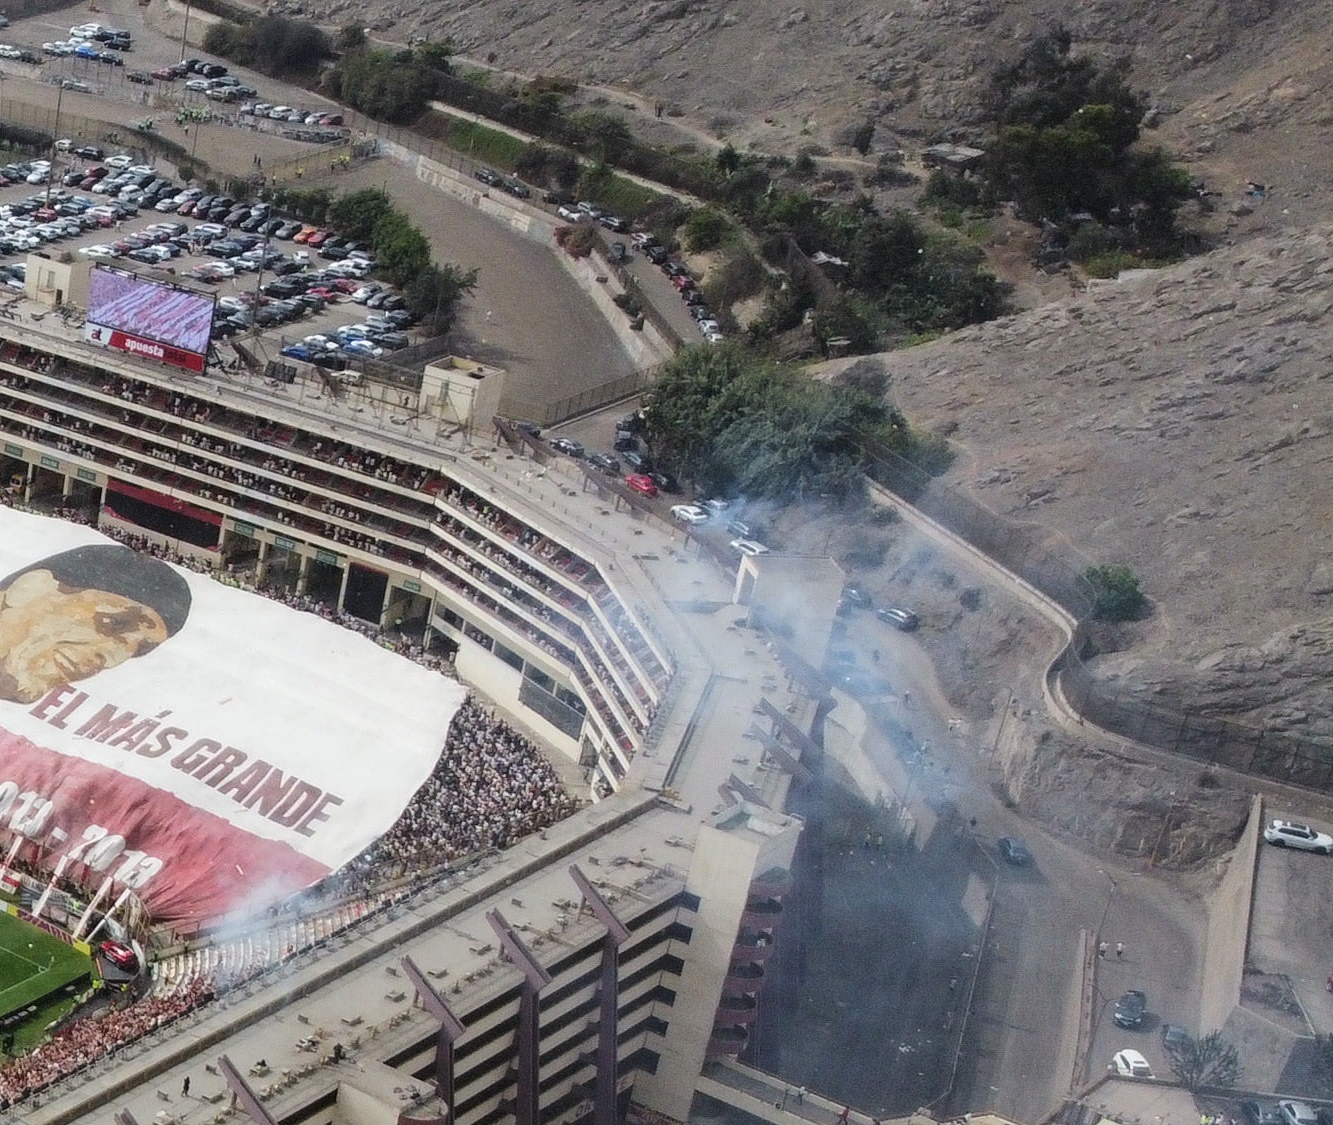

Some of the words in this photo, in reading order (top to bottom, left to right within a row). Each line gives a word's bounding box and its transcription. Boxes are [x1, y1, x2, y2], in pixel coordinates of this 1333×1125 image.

[124, 338, 164, 358] apuesta
[27, 683, 90, 730] EL
[74, 703, 189, 759] MÁS
[170, 737, 345, 839] GRANDE
[67, 824, 164, 889] 2013
